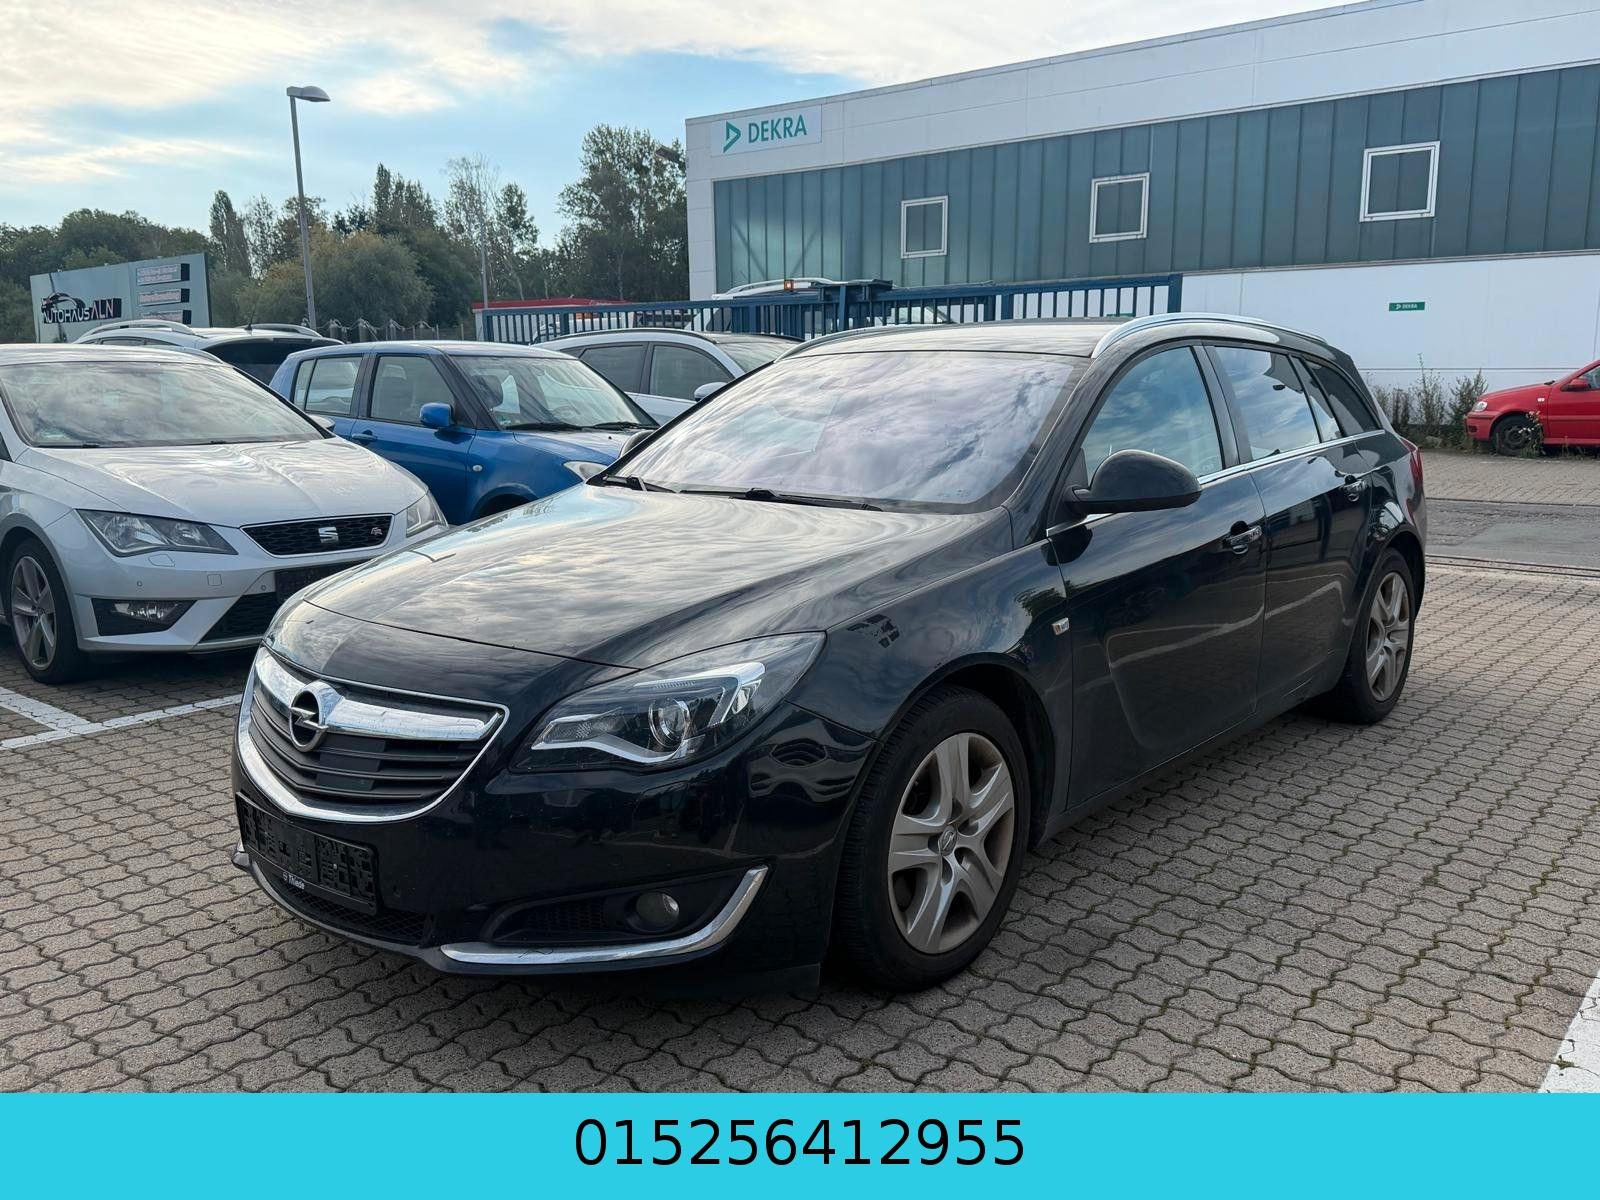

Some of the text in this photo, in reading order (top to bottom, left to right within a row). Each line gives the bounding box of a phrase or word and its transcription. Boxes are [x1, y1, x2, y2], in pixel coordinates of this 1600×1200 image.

[748, 114, 807, 143] DEKRA
[43, 298, 114, 324] AUTOHAUS ALN
